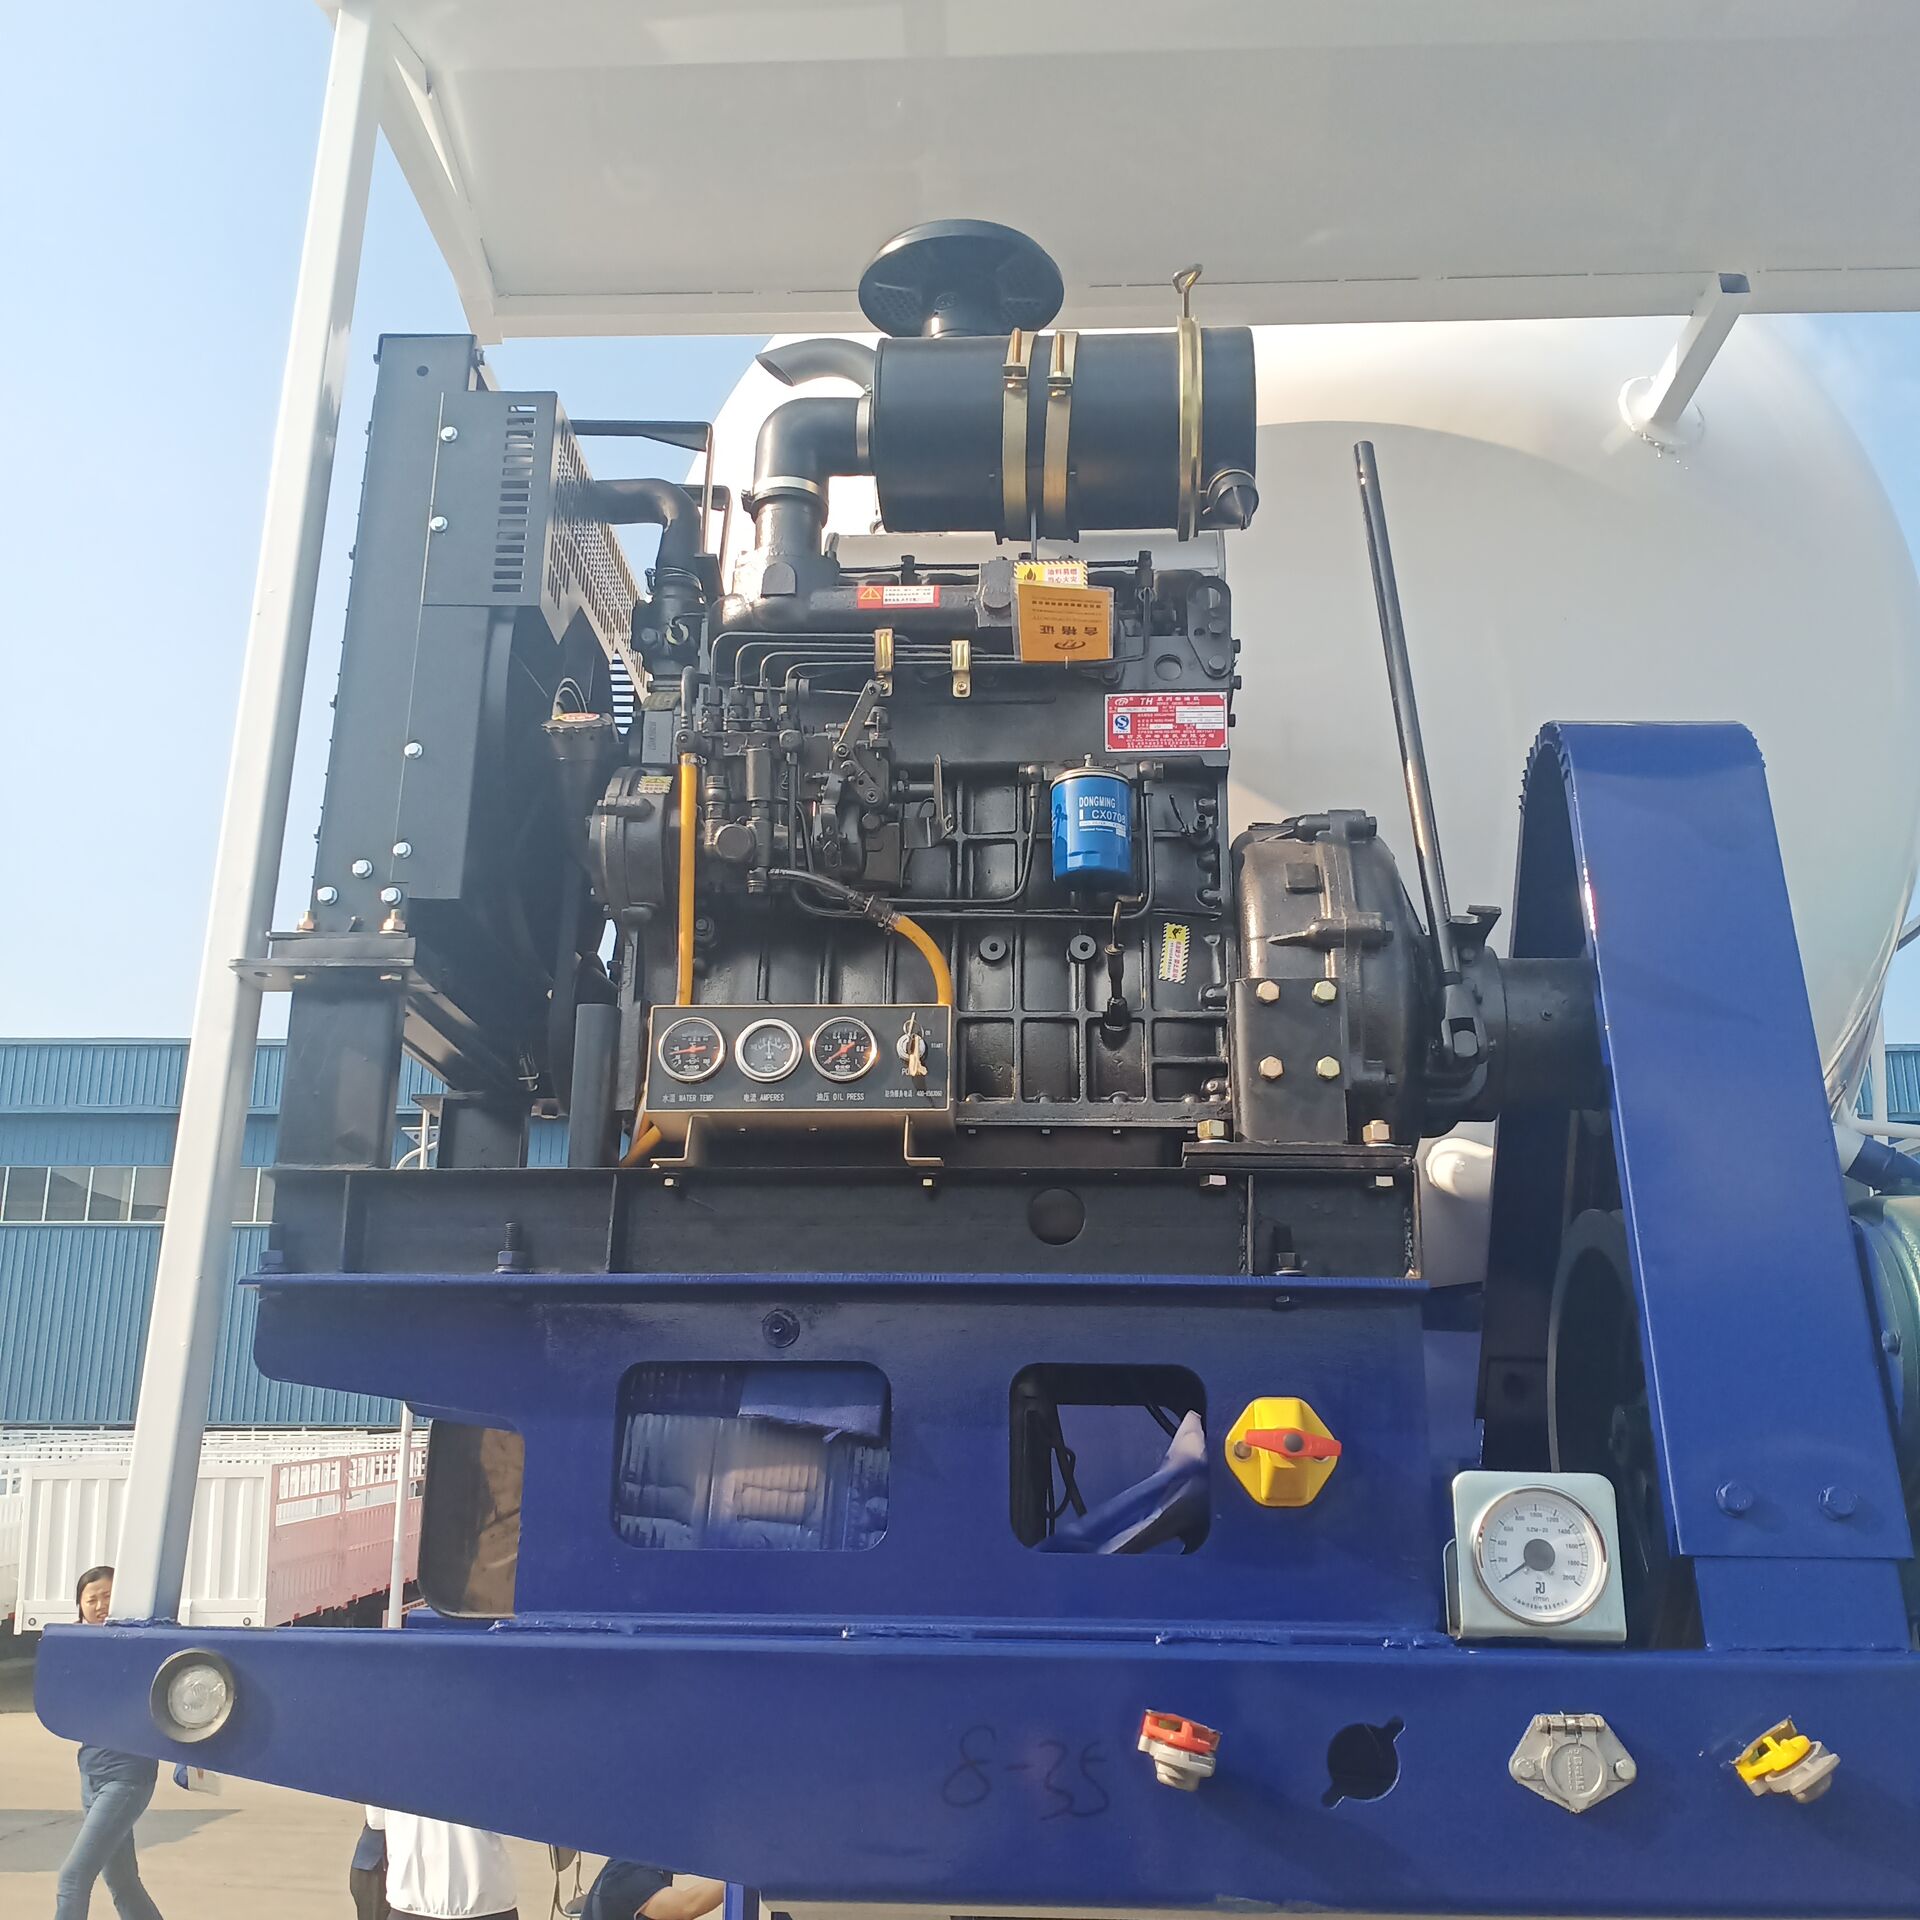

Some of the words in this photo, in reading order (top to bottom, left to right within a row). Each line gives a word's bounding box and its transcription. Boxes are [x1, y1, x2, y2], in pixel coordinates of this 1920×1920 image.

[1039, 625, 1098, 636] 合格证
[1139, 697, 1154, 706] TH
[1079, 796, 1116, 808] DONGMING
[678, 1094, 697, 1102] WATER
[699, 1094, 714, 1102] TEMP
[759, 1093, 785, 1102] AMPERES
[832, 1093, 844, 1101] OIL
[846, 1093, 865, 1101] PRESS
